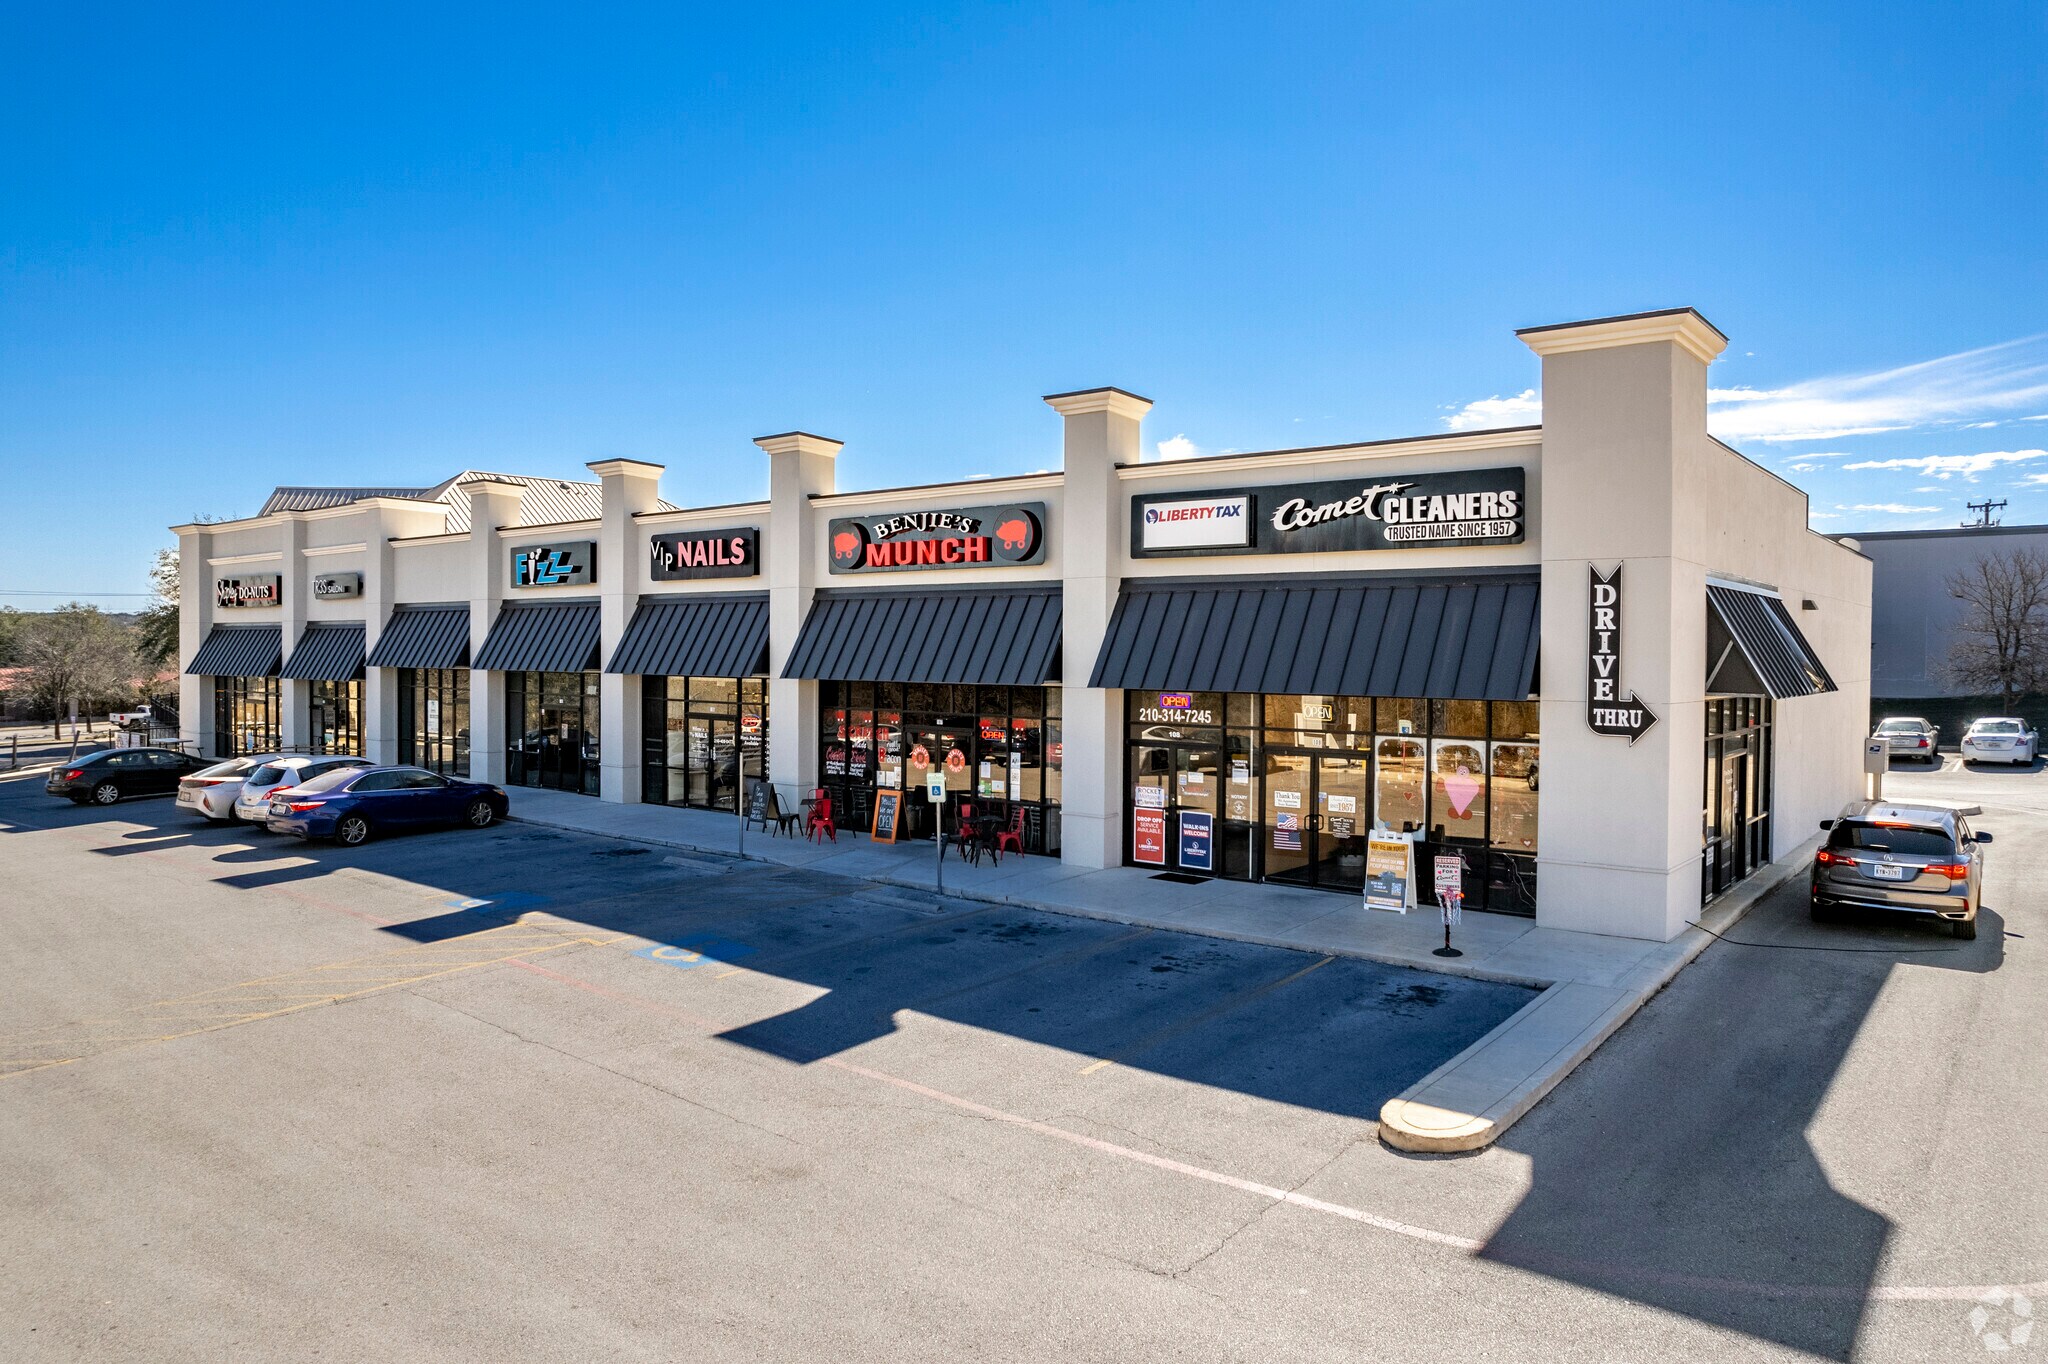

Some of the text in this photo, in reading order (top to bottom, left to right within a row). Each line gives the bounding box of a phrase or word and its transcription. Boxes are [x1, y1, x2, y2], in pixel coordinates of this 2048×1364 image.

[1270, 484, 1400, 531] Comet
[1384, 491, 1518, 524] CLEANERS
[872, 511, 973, 539] BENJIE'S
[1388, 520, 1511, 540] TRUSTED NAME SINCE 1957
[677, 537, 745, 568] NAILS
[866, 536, 988, 567] MUNCH
[238, 585, 269, 600] DO-NUTS
[1592, 584, 1617, 701] DRIVE
[1162, 695, 1189, 707] OPEN
[1139, 708, 1212, 724] 210-314-7245
[1304, 705, 1331, 719] OPEN
[1593, 708, 1643, 728] THRU
[981, 730, 1005, 739] OPEN
[1338, 802, 1354, 812] 1957
[1183, 823, 1209, 831] WALK-INS
[1435, 857, 1460, 865] RESERVED
